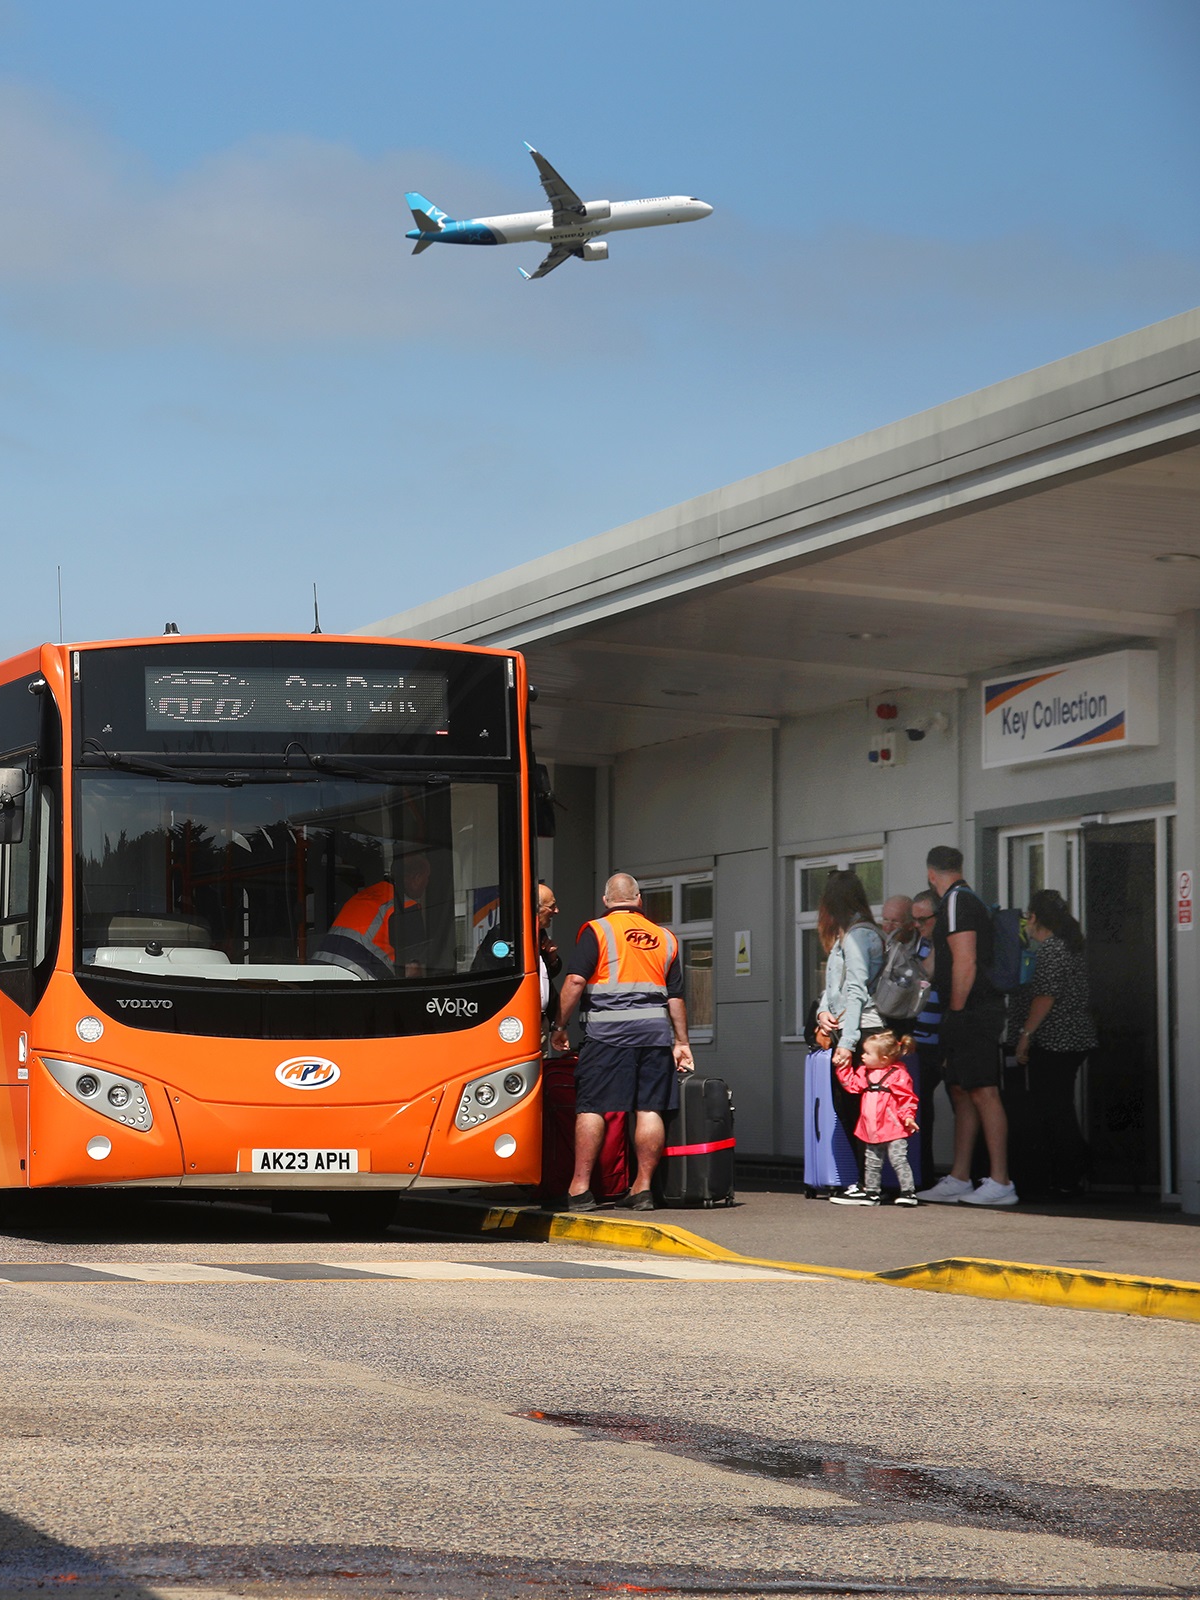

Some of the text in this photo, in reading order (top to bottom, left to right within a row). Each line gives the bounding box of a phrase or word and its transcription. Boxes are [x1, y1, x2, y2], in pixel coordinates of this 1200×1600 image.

[1002, 691, 1108, 740] Key Collection
[626, 931, 658, 946] APH
[116, 999, 174, 1009] VOLVO
[425, 997, 479, 1017] eVoRa
[284, 1064, 332, 1081] APH
[260, 1152, 350, 1170] AK23 APH
